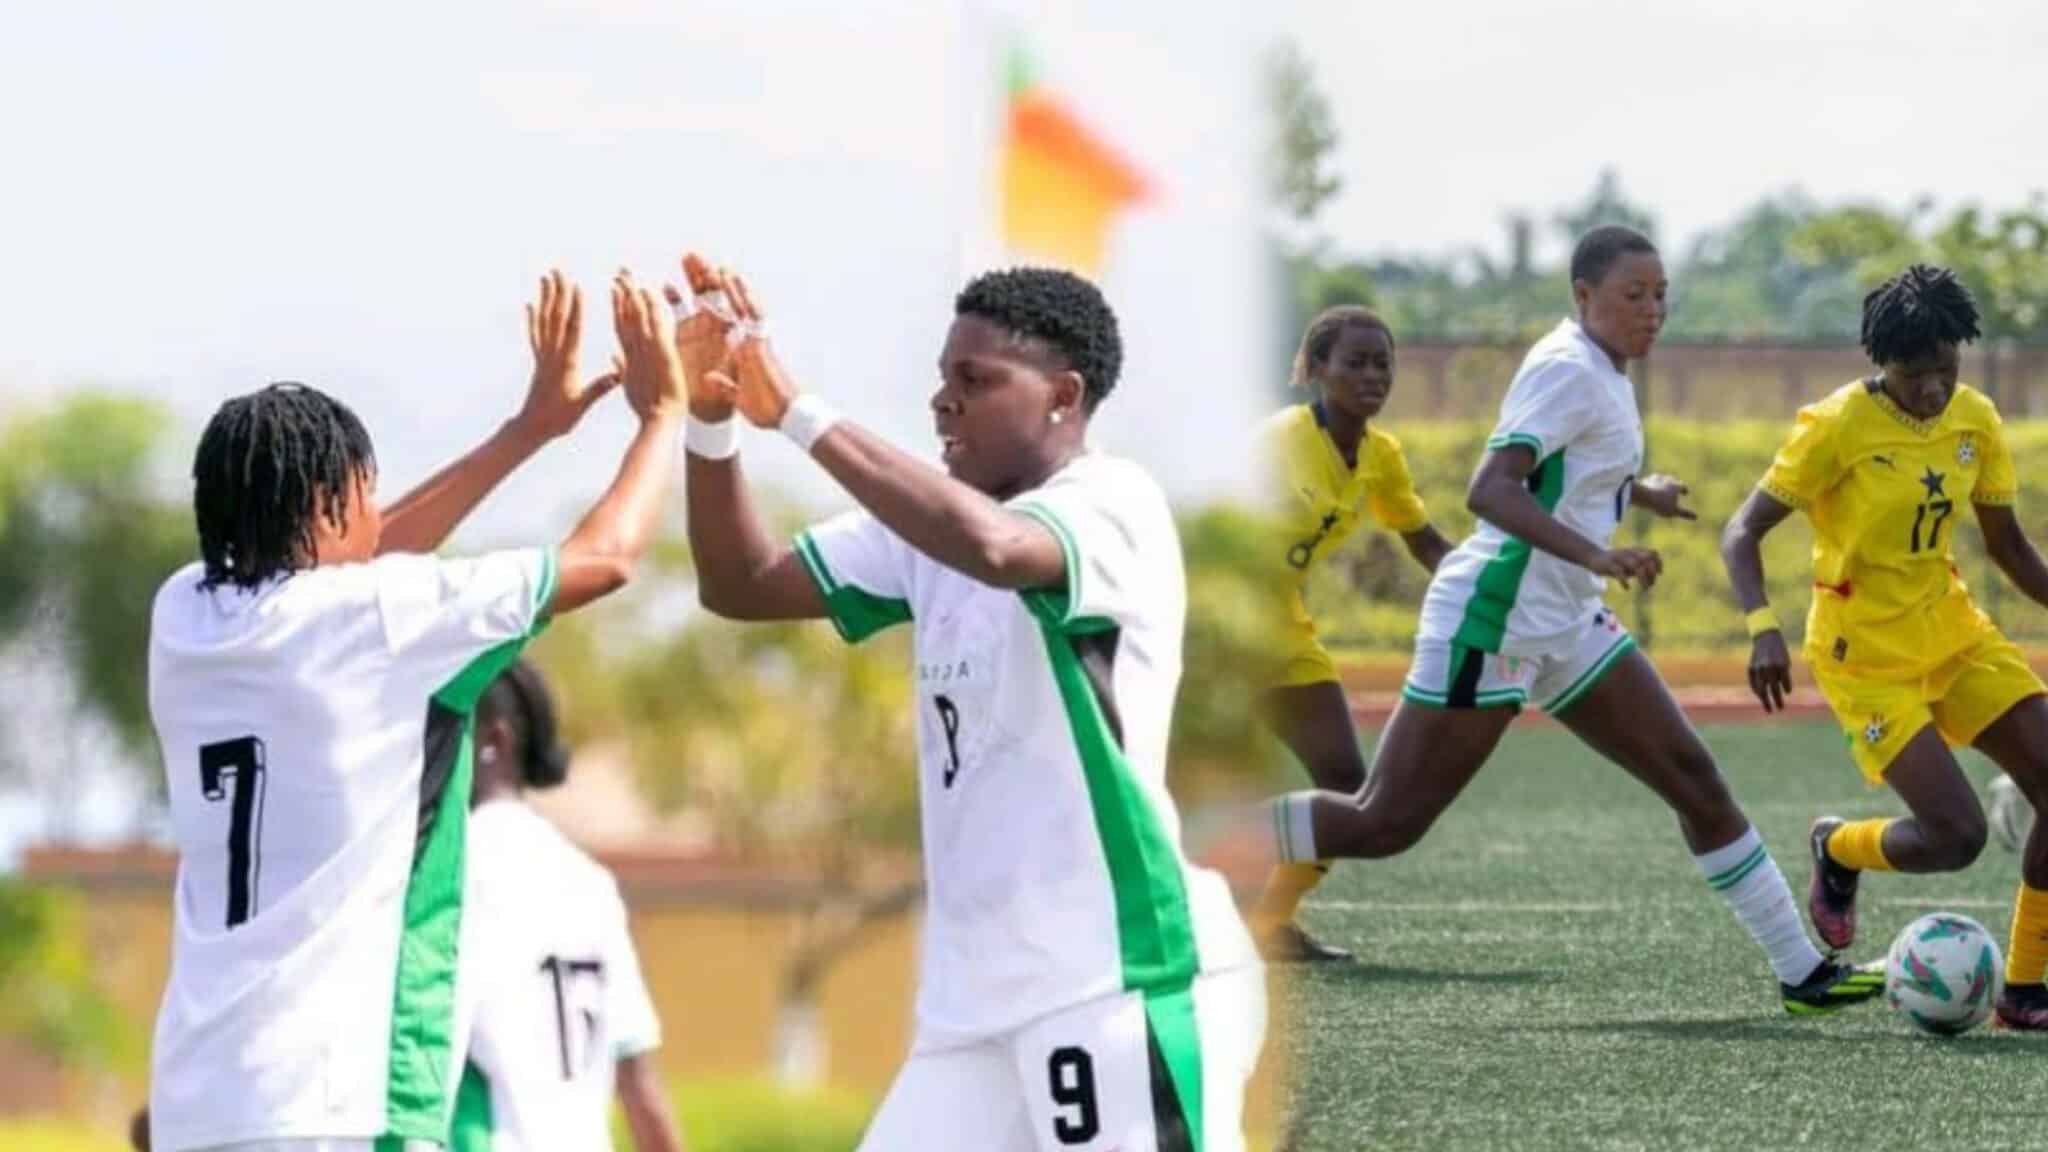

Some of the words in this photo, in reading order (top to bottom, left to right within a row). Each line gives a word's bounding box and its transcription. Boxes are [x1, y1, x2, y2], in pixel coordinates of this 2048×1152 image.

[1909, 499, 1952, 553] 17
[198, 733, 266, 932] 7
[1047, 1046, 1101, 1145] 9
